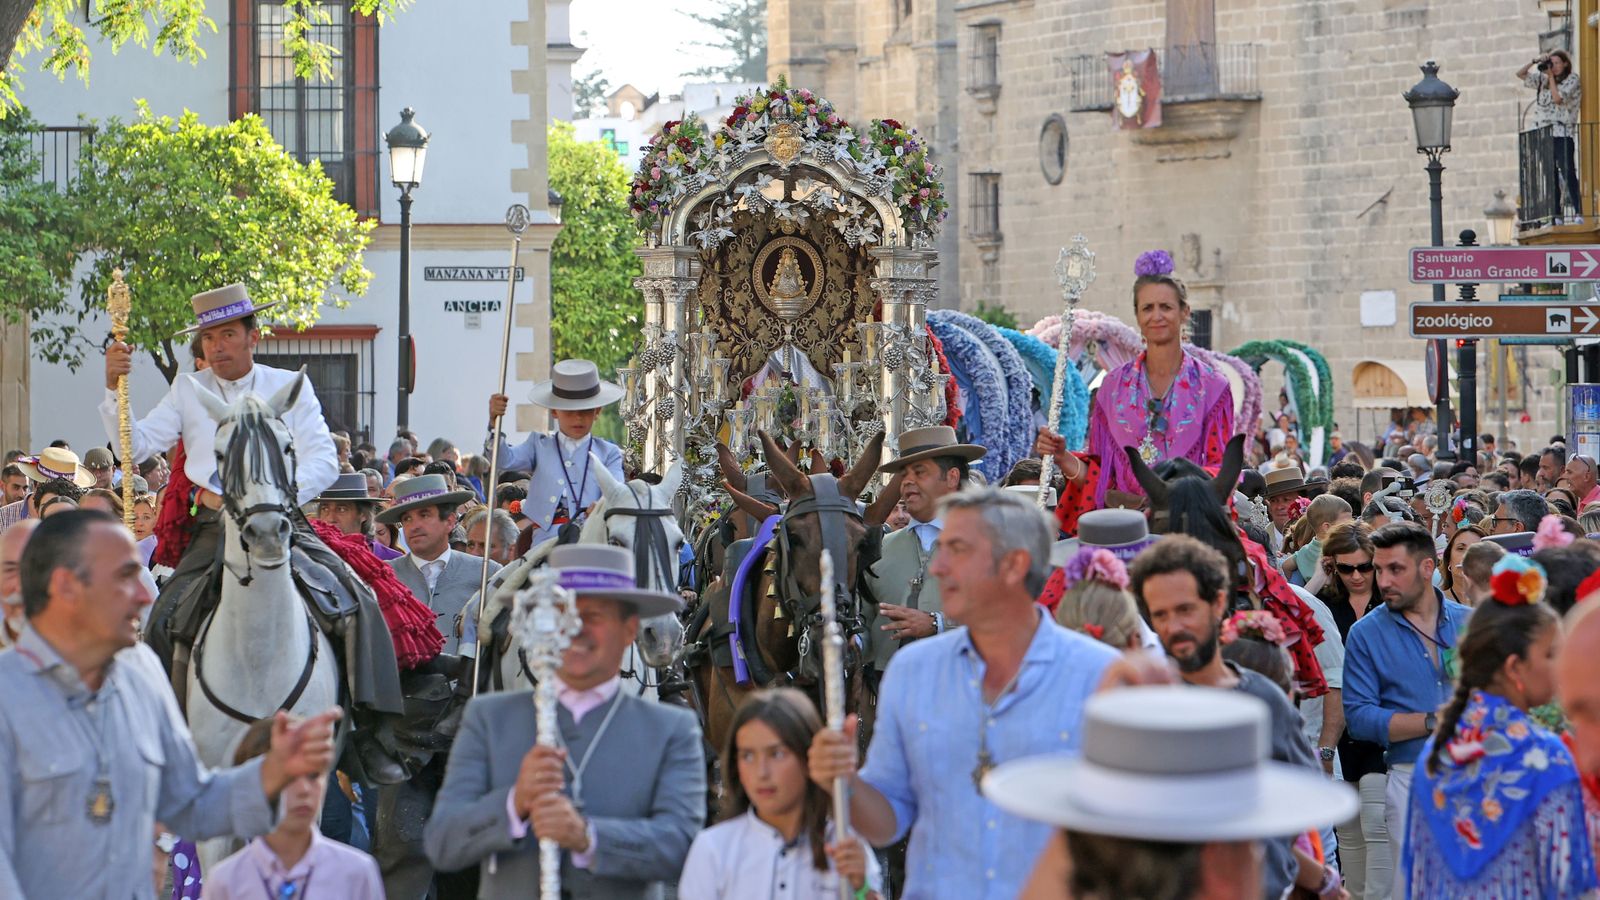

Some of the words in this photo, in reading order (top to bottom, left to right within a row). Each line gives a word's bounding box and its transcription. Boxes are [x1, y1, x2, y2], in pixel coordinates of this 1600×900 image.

[1417, 253, 1474, 262] Santuario
[426, 268, 483, 279] MANZANA
[1416, 266, 1444, 278] San
[1449, 266, 1482, 278] Juan
[1487, 266, 1538, 278] Grande
[445, 301, 500, 312] ANCHA
[1416, 314, 1493, 329] zoológico
